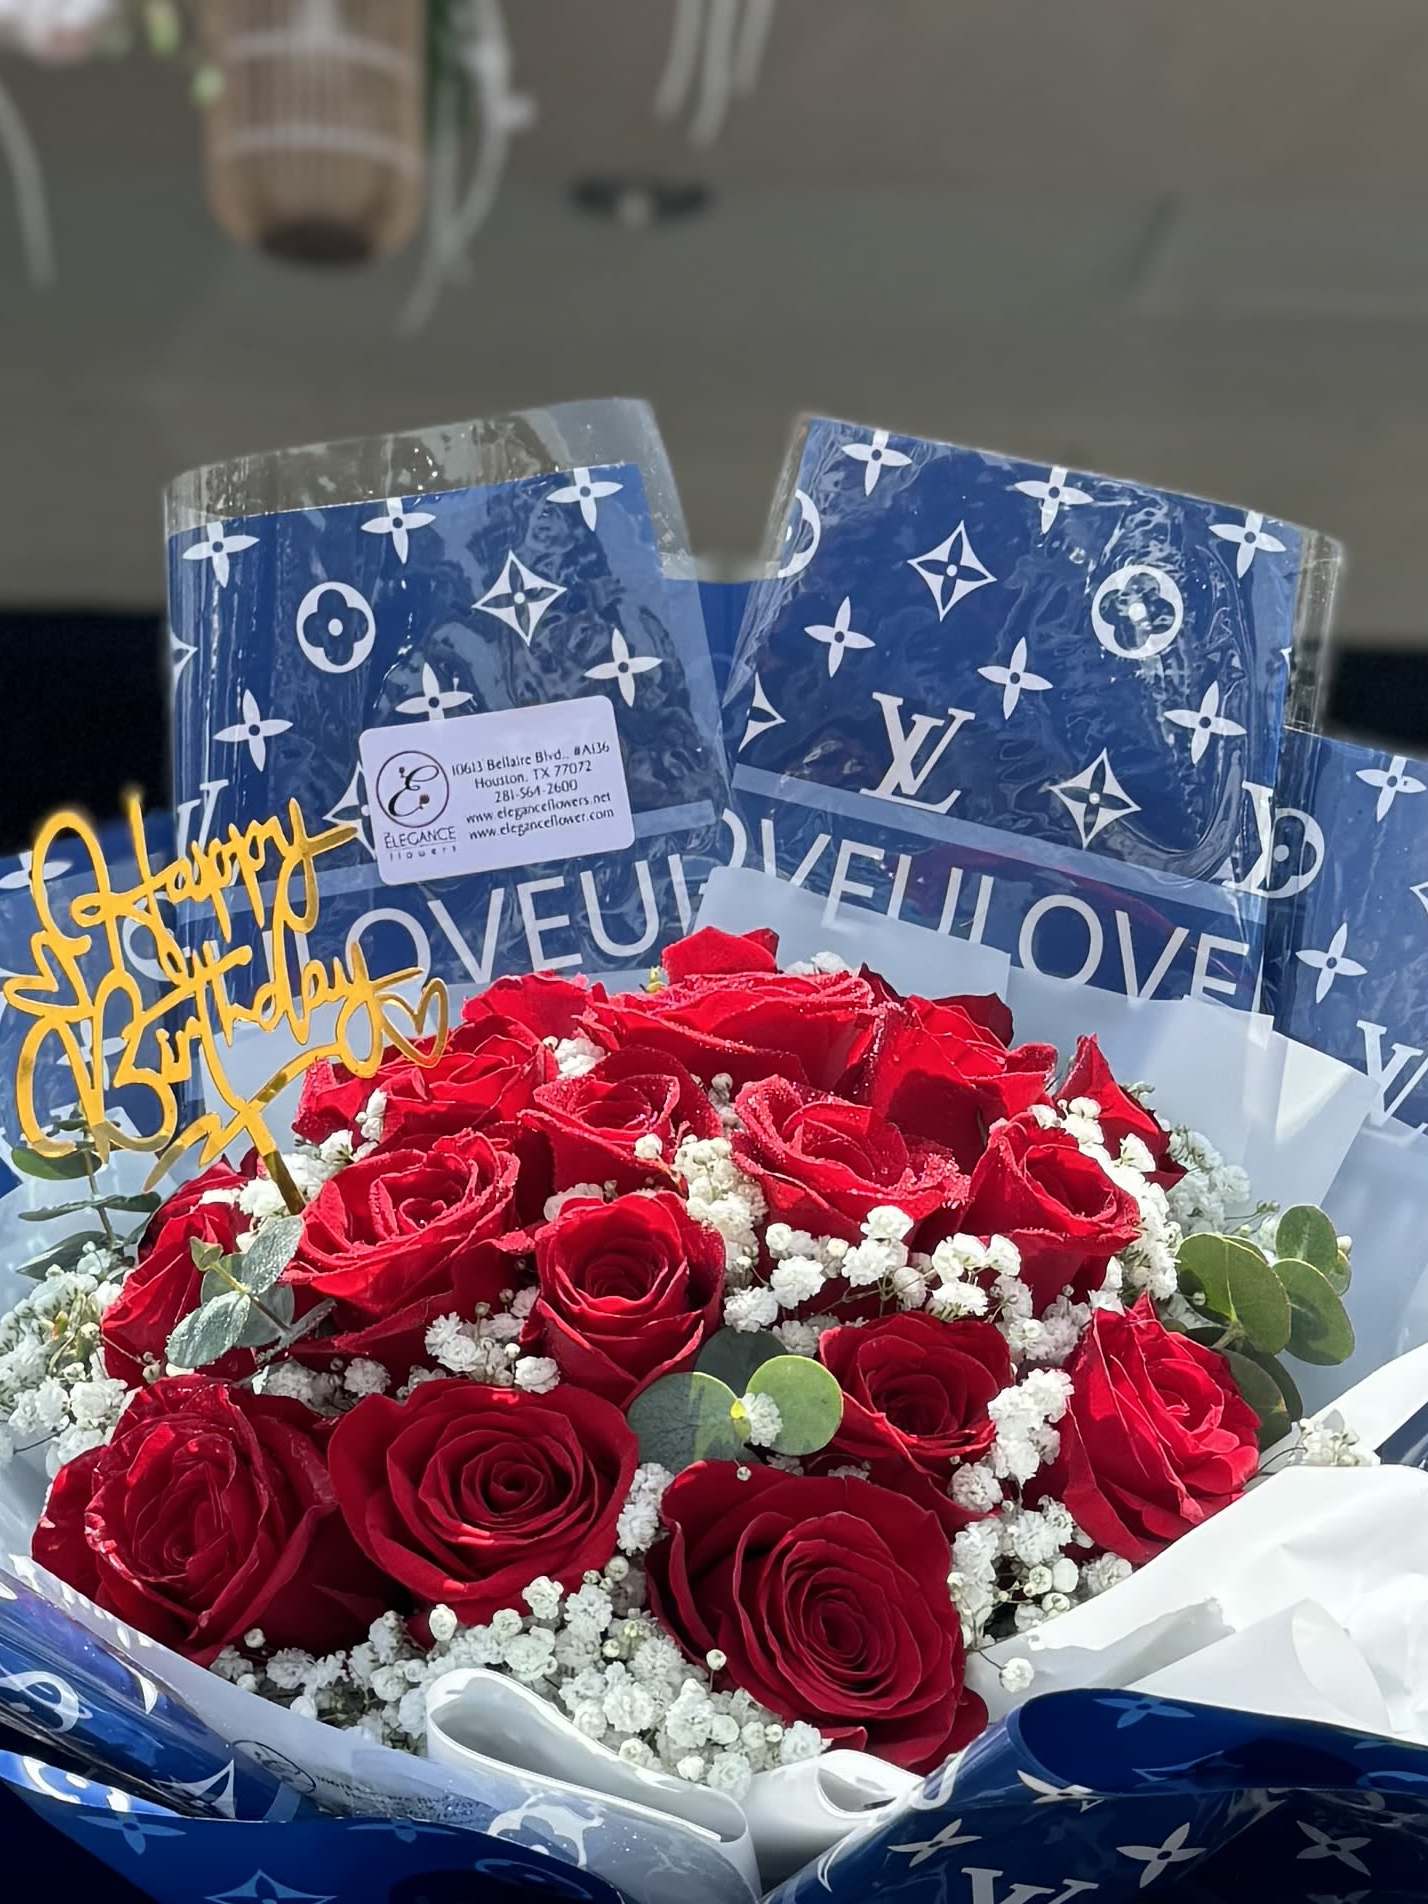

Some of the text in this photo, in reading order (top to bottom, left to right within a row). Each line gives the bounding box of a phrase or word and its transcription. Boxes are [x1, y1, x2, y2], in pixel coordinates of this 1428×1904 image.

[451, 760, 484, 777] 10613
[487, 755, 532, 772] Bellaire
[533, 767, 551, 781] TX
[554, 759, 593, 777] 77072
[494, 778, 579, 804] 281-564-2600
[31, 786, 360, 944] Happy
[6, 930, 424, 1192] Birthday
